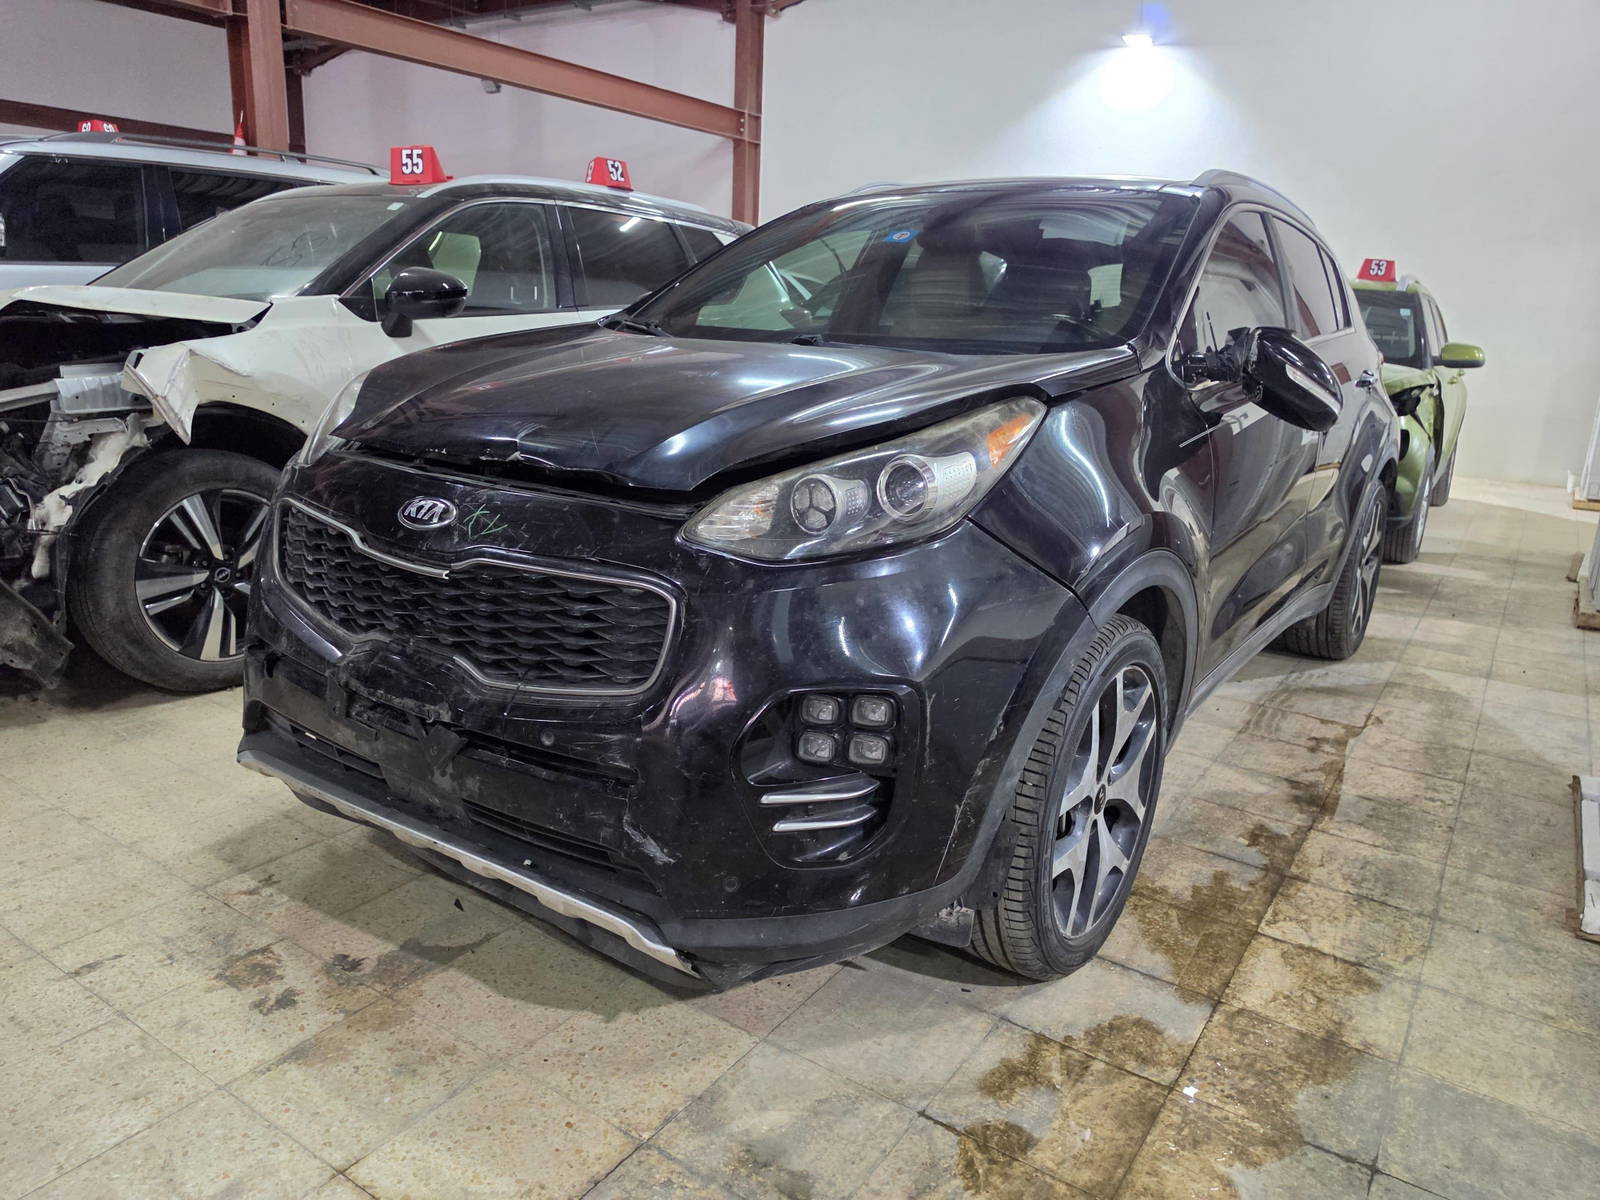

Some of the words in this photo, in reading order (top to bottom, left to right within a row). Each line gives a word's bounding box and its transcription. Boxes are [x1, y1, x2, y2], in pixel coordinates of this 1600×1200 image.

[402, 149, 423, 174] 55
[607, 160, 625, 182] 52
[1370, 260, 1388, 276] 53
[403, 499, 445, 523] KIA
